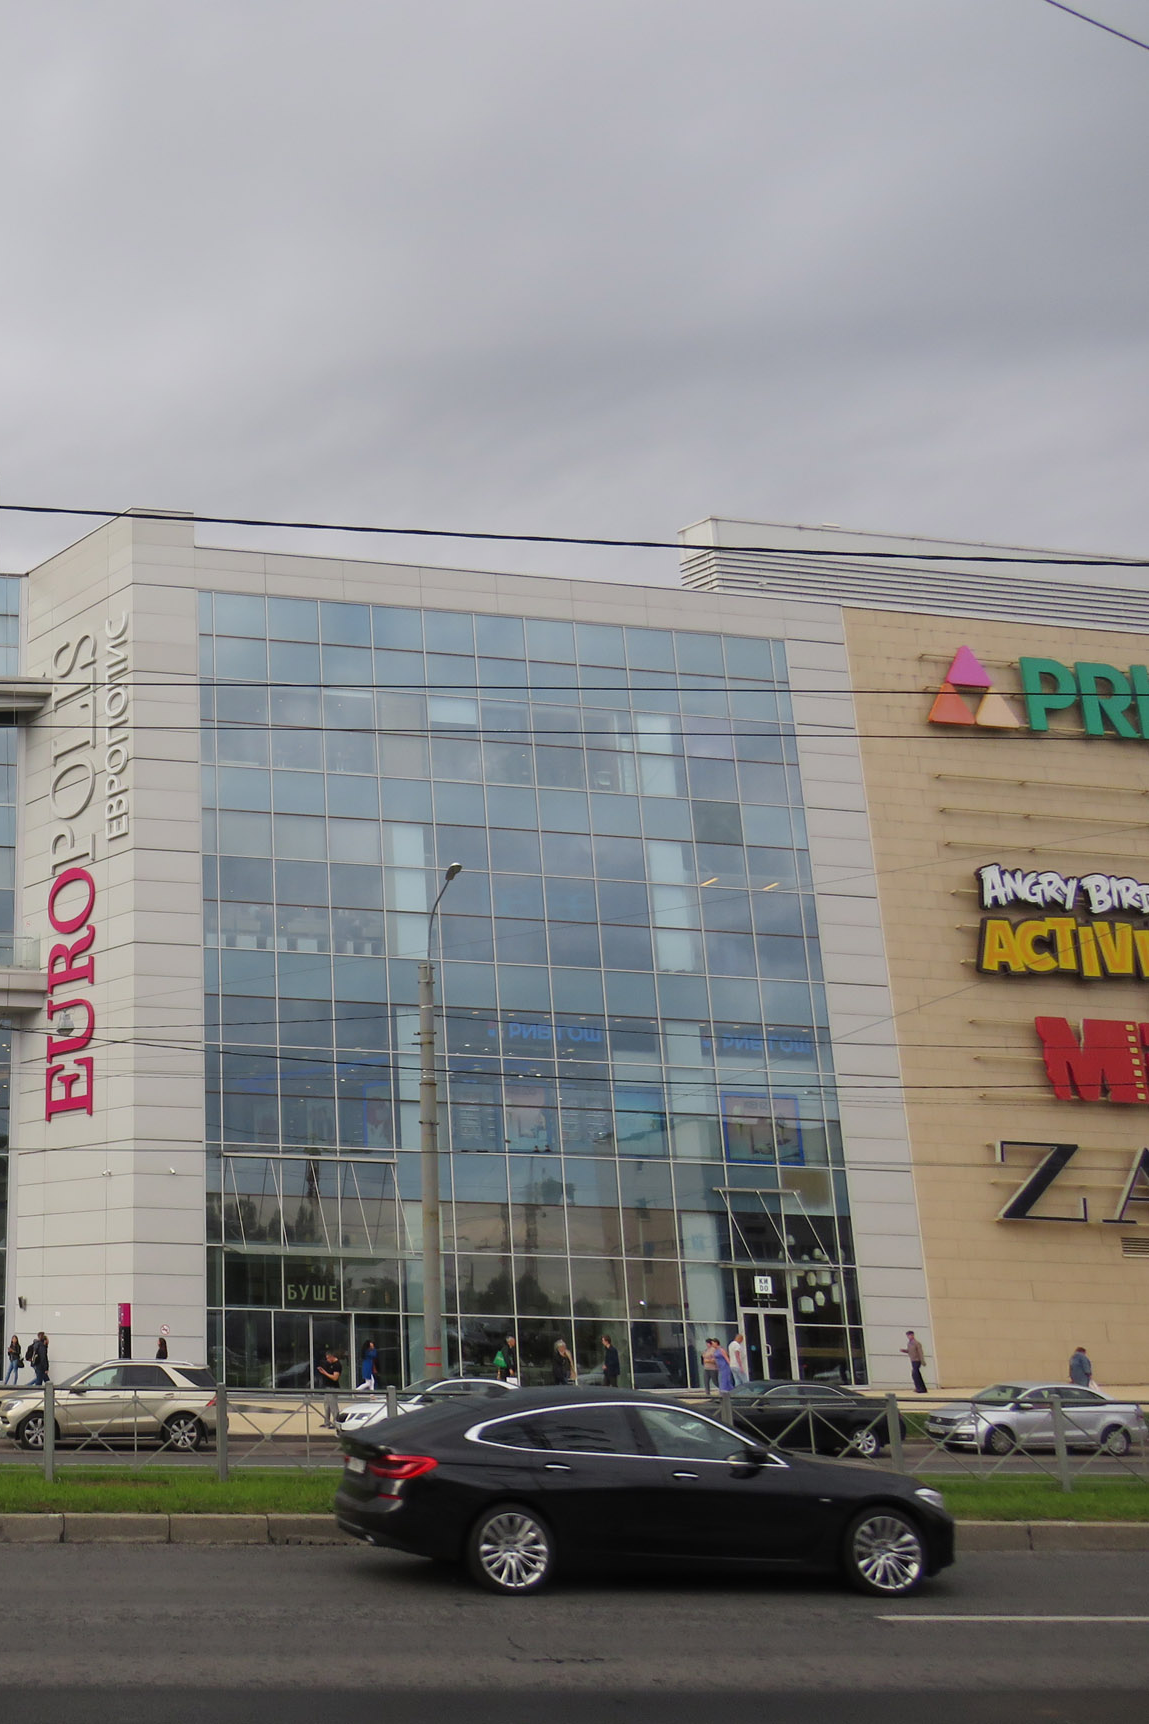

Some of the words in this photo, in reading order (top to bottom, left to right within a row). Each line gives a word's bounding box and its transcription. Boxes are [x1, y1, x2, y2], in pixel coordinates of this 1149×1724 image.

[105, 609, 130, 842] ЕВРОПОЛИС
[1018, 656, 1149, 740] PRI
[45, 631, 98, 1124] EUROPOLIS
[977, 864, 1077, 911] ANGRY
[287, 1284, 338, 1302] БУШЕ
